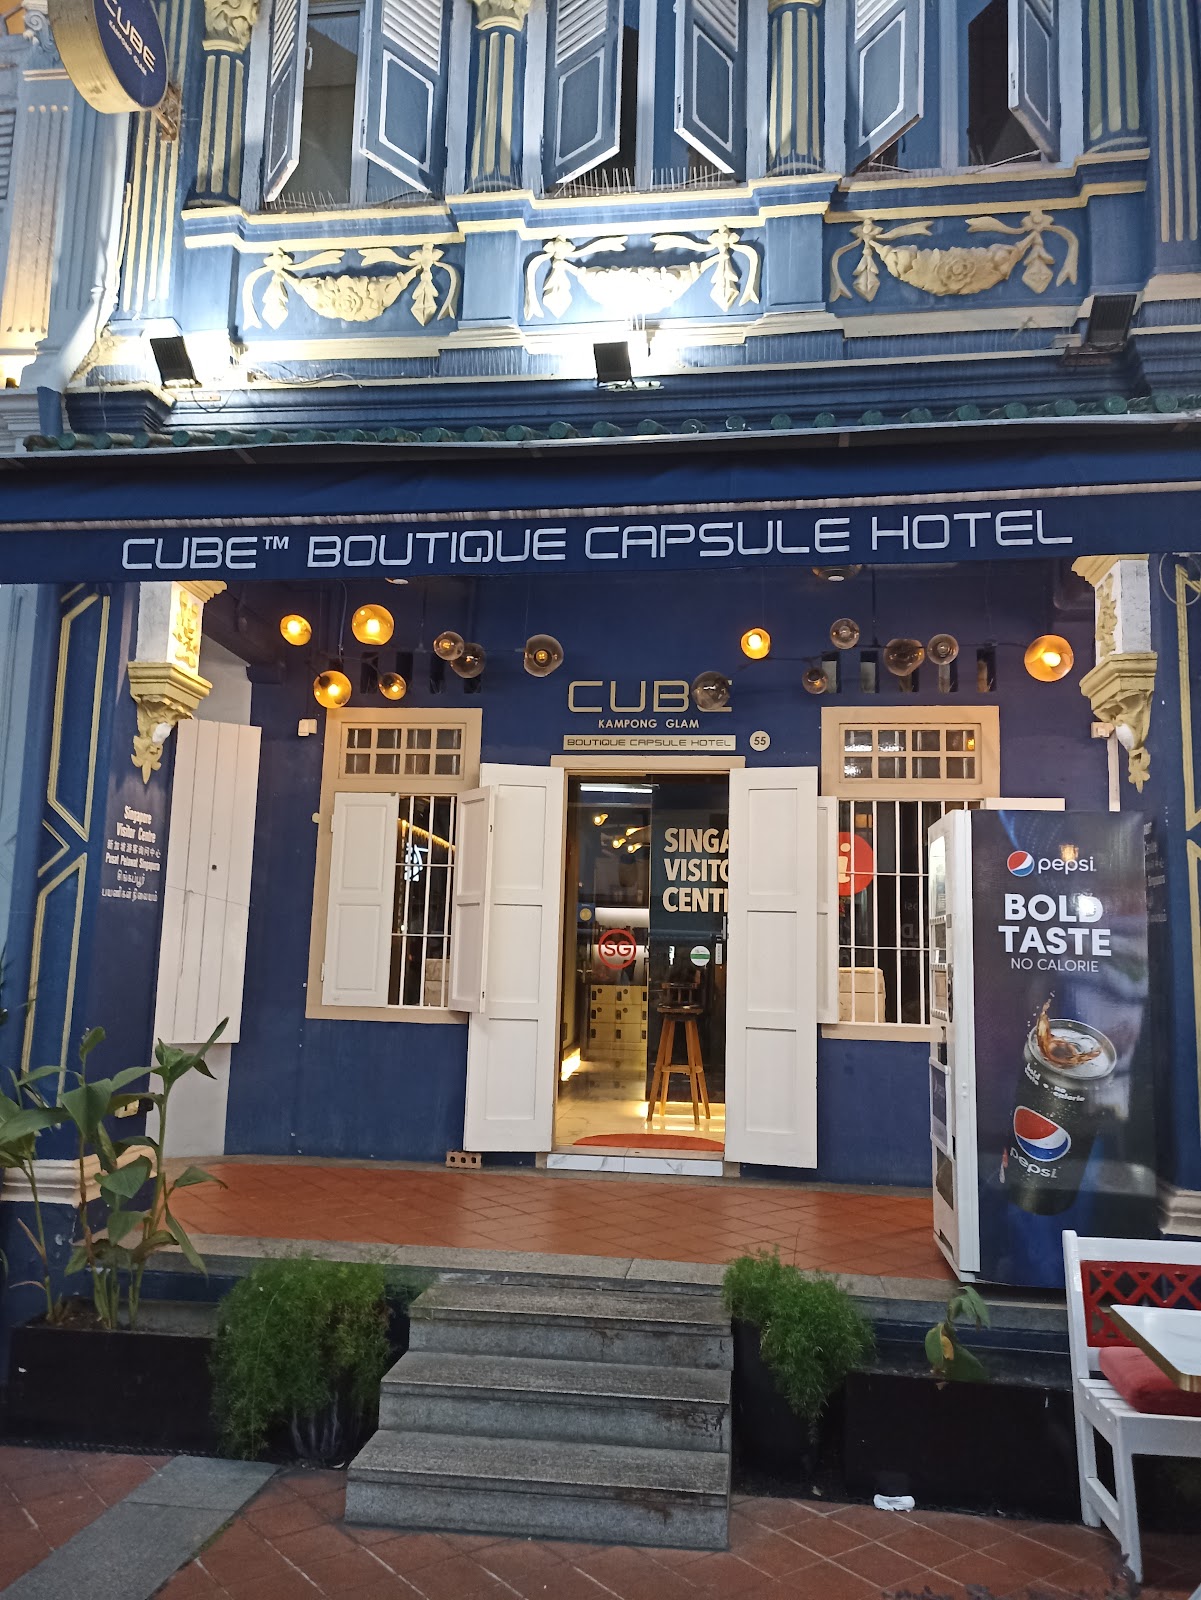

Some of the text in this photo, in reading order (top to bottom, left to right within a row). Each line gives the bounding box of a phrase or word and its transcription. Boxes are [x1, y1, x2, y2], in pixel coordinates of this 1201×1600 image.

[307, 527, 567, 568] BOUTIQUE
[585, 517, 850, 560] CAPSULE
[871, 509, 1074, 550] HOTEL
[598, 719, 700, 729] KAMPONG GLAM
[567, 738, 732, 747] BOUTIQUE CAPSULE HOTEL
[753, 736, 767, 746] 55
[124, 805, 152, 825] Singapore
[116, 822, 156, 844] Visitor Centre
[1037, 856, 1095, 875] pepsi
[1004, 893, 1104, 923] BOLD
[604, 941, 632, 957] SG
[998, 926, 1112, 956] TASTE
[1011, 958, 1099, 972] NO CALORIE
[1010, 1147, 1057, 1178] pepsi
